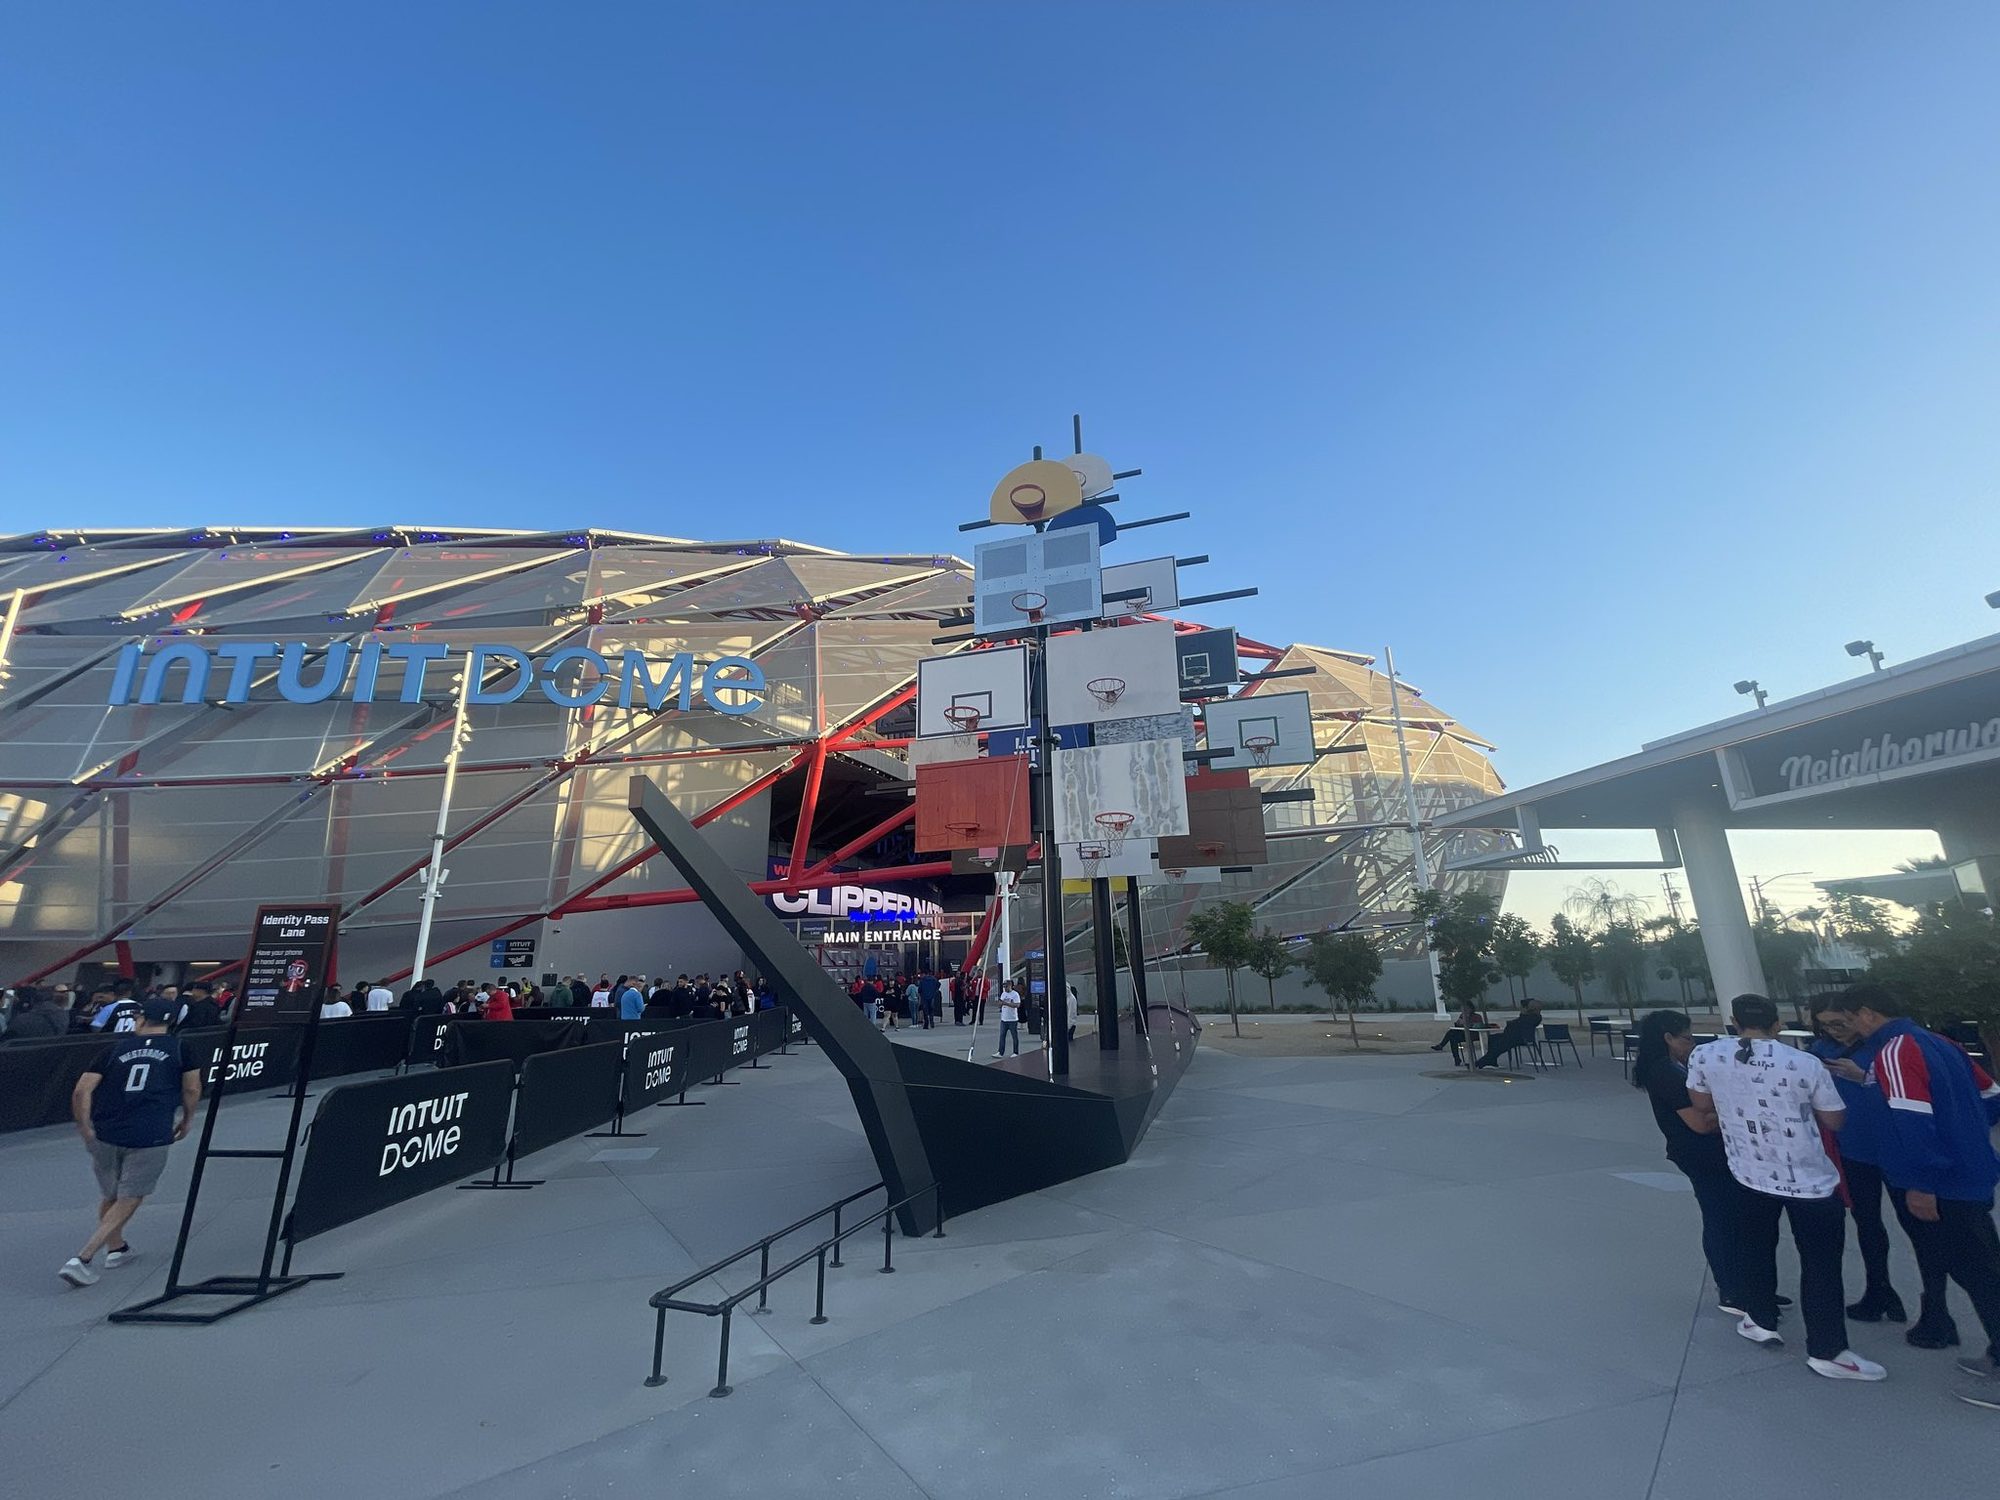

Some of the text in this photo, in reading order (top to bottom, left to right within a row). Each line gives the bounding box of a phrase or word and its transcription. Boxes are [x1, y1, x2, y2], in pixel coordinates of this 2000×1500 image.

[262, 914, 330, 926] Identity Pass
[280, 927, 306, 938] Lane
[823, 929, 942, 944] MAIN ENTRANCE
[259, 968, 276, 976] ready
[125, 1064, 150, 1092] 0
